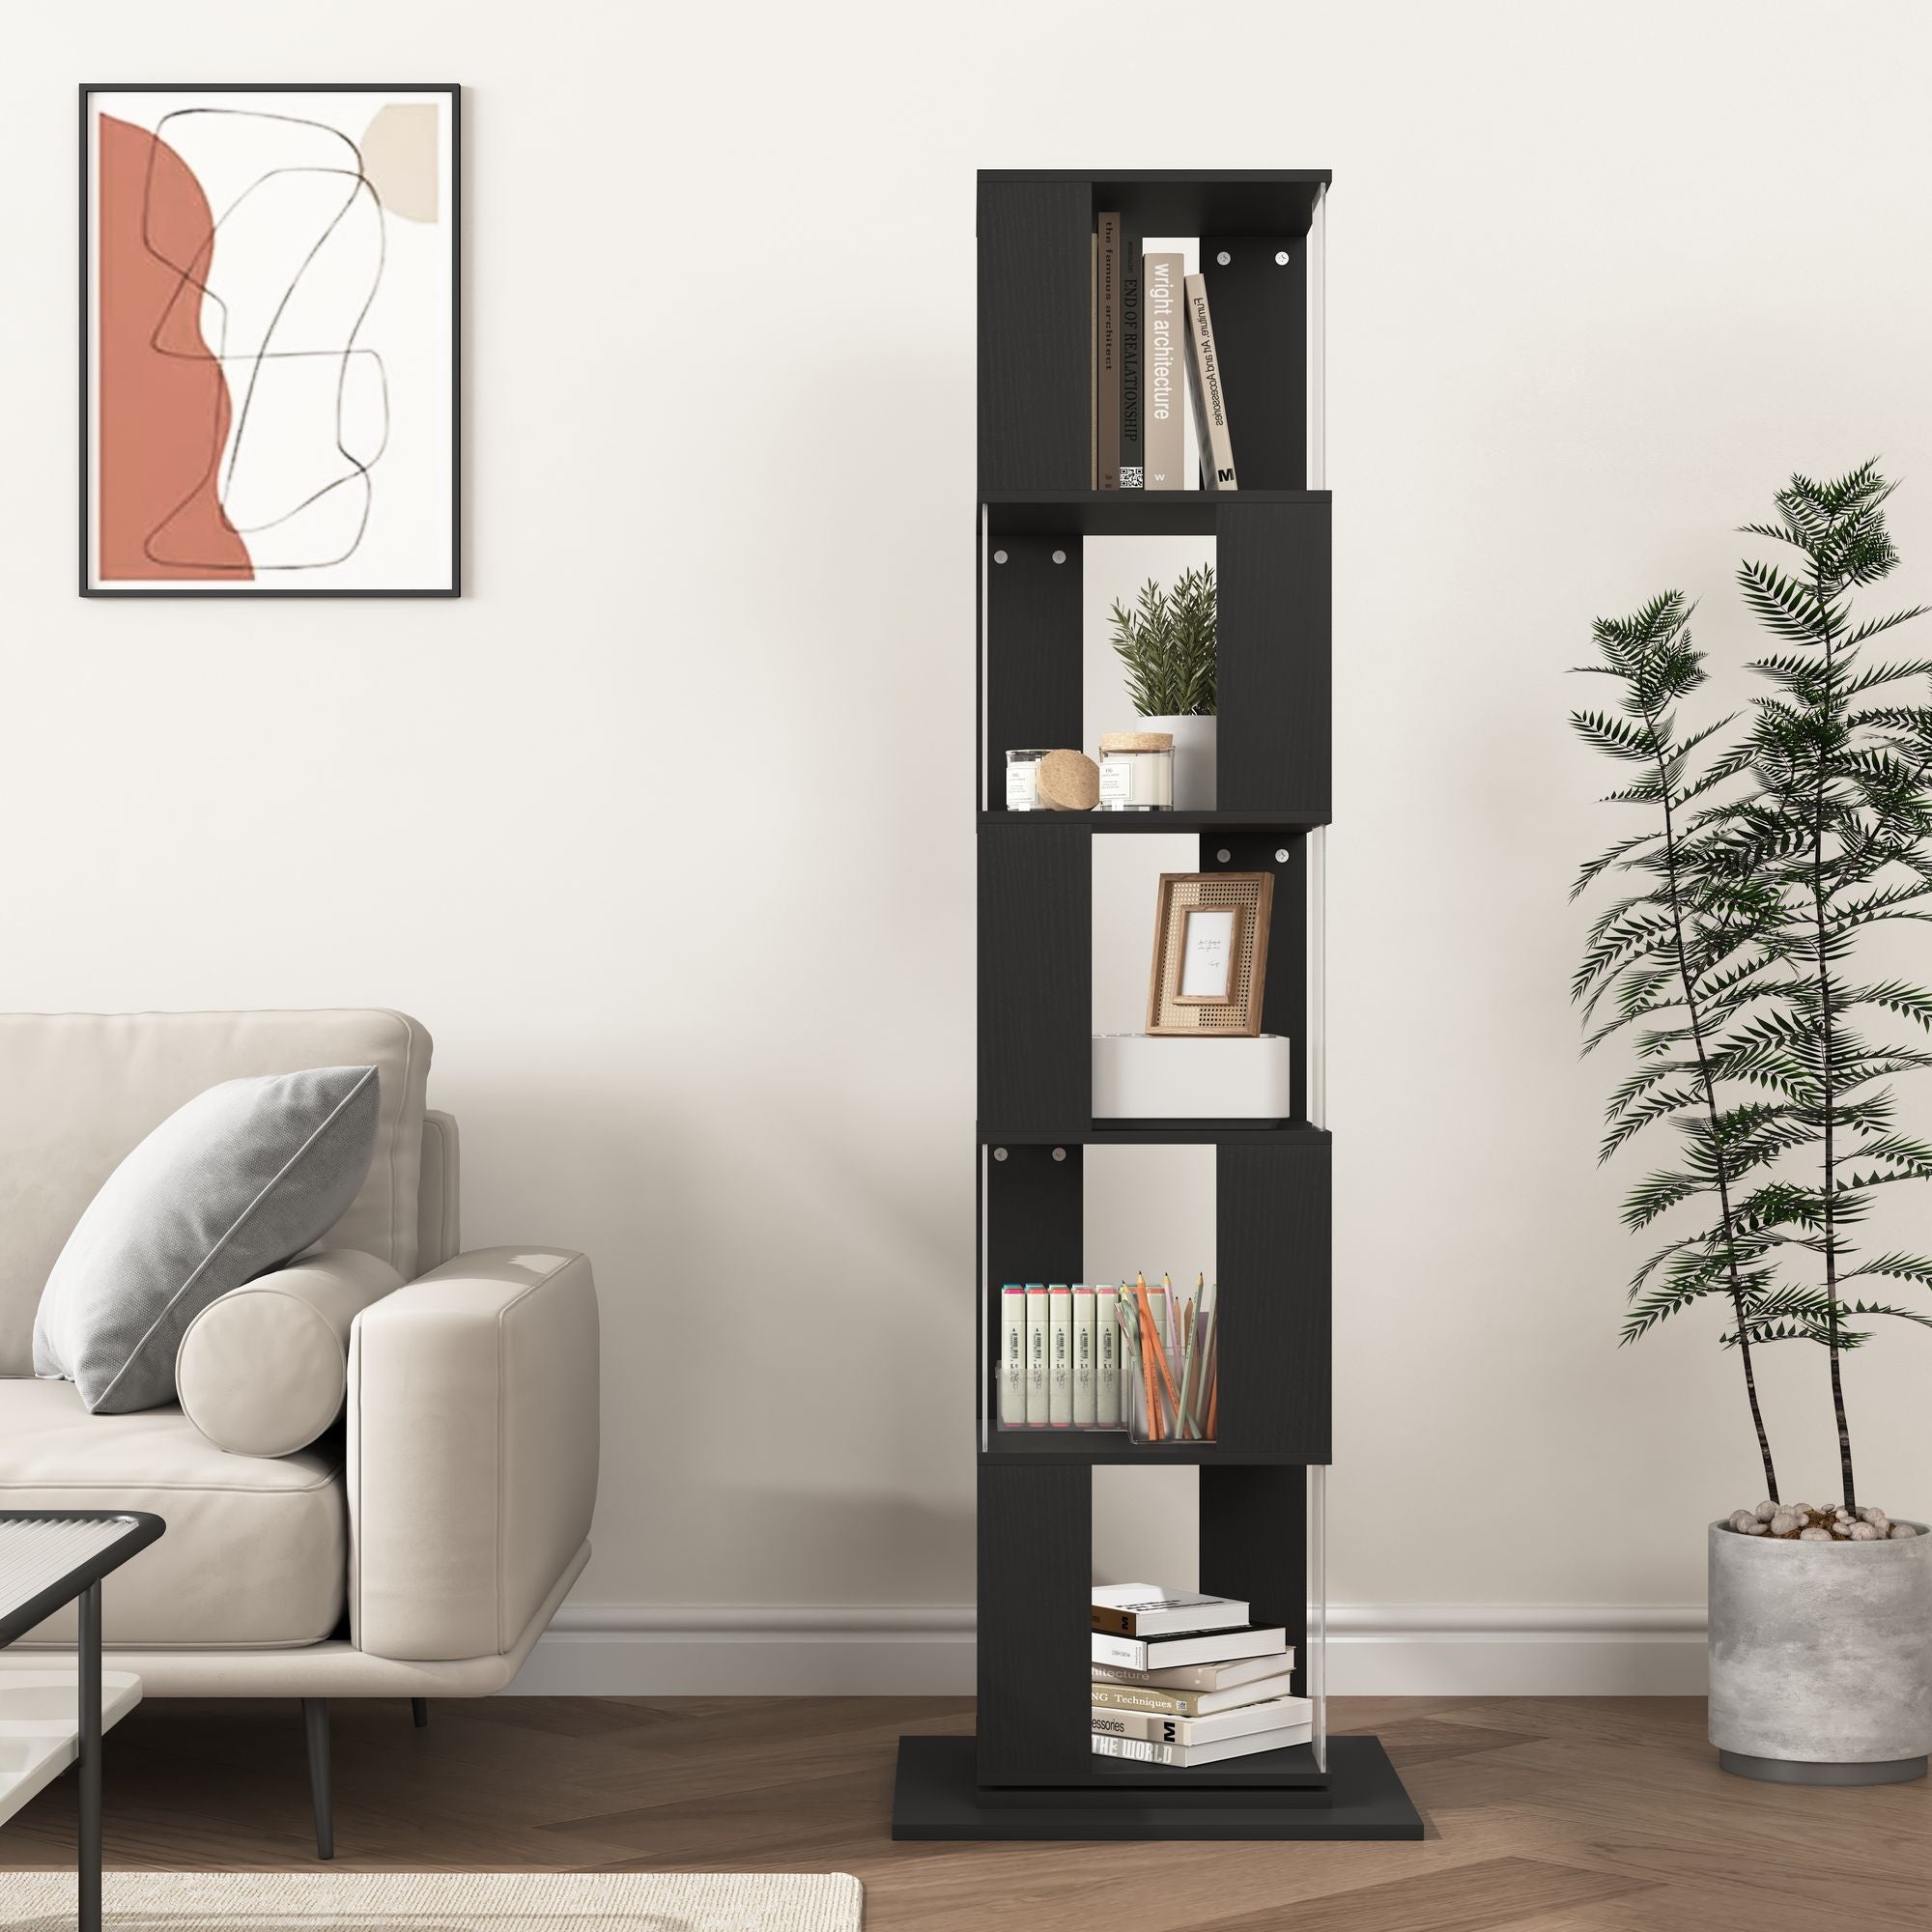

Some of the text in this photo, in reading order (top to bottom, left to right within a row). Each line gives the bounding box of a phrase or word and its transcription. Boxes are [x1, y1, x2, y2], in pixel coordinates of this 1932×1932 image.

[1124, 279, 1137, 308] END
[1124, 311, 1137, 329] OF
[1150, 264, 1174, 419] wright architecture
[1124, 333, 1137, 441] REALATIONSHIP
[1217, 469, 1235, 482] M
[1092, 1666, 1151, 1681] hitecture
[1092, 1692, 1172, 1711] NG Techniques
[1092, 1718, 1124, 1733] essories
[1163, 1721, 1176, 1743] M
[1092, 1734, 1173, 1764] THE WORLD
